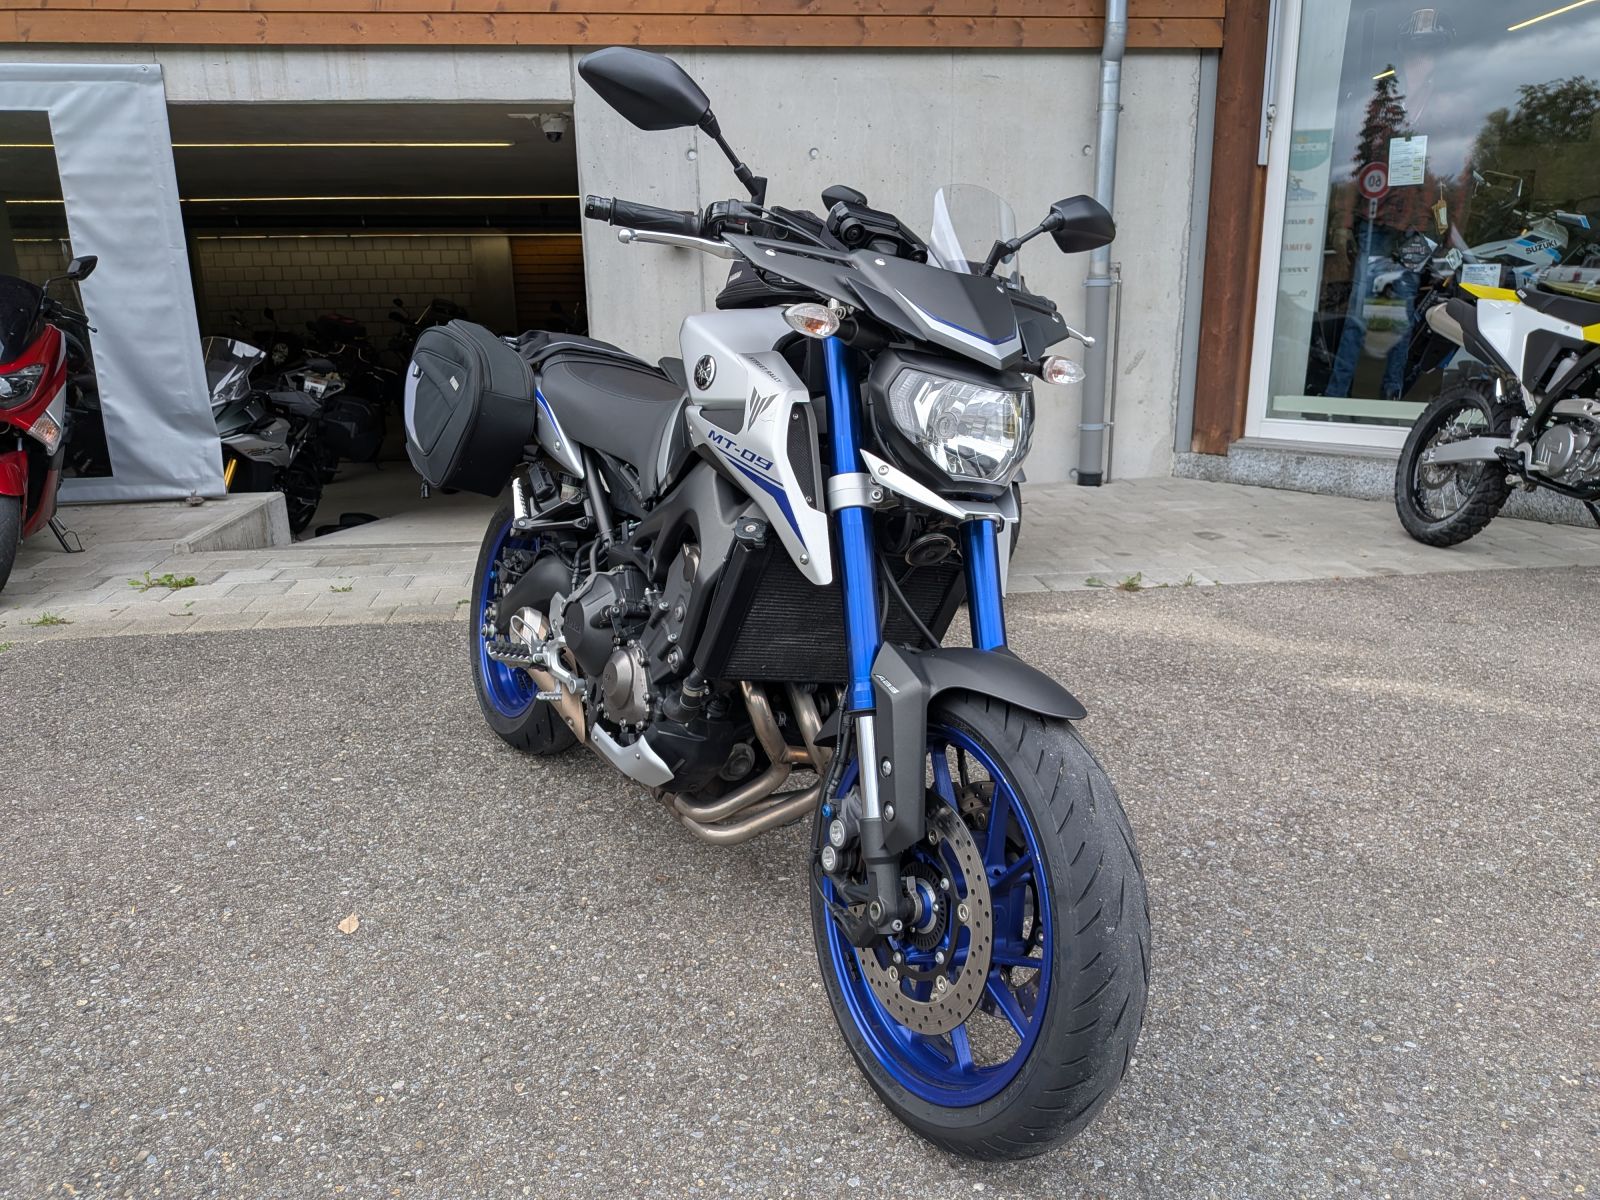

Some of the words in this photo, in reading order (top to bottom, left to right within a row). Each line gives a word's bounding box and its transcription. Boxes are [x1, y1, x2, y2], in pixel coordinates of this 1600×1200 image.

[1525, 239, 1557, 254] SUZUKI
[749, 356, 767, 371] STREET
[766, 370, 783, 383] RALLY
[708, 430, 773, 471] MT-09
[874, 674, 900, 694] ABS
